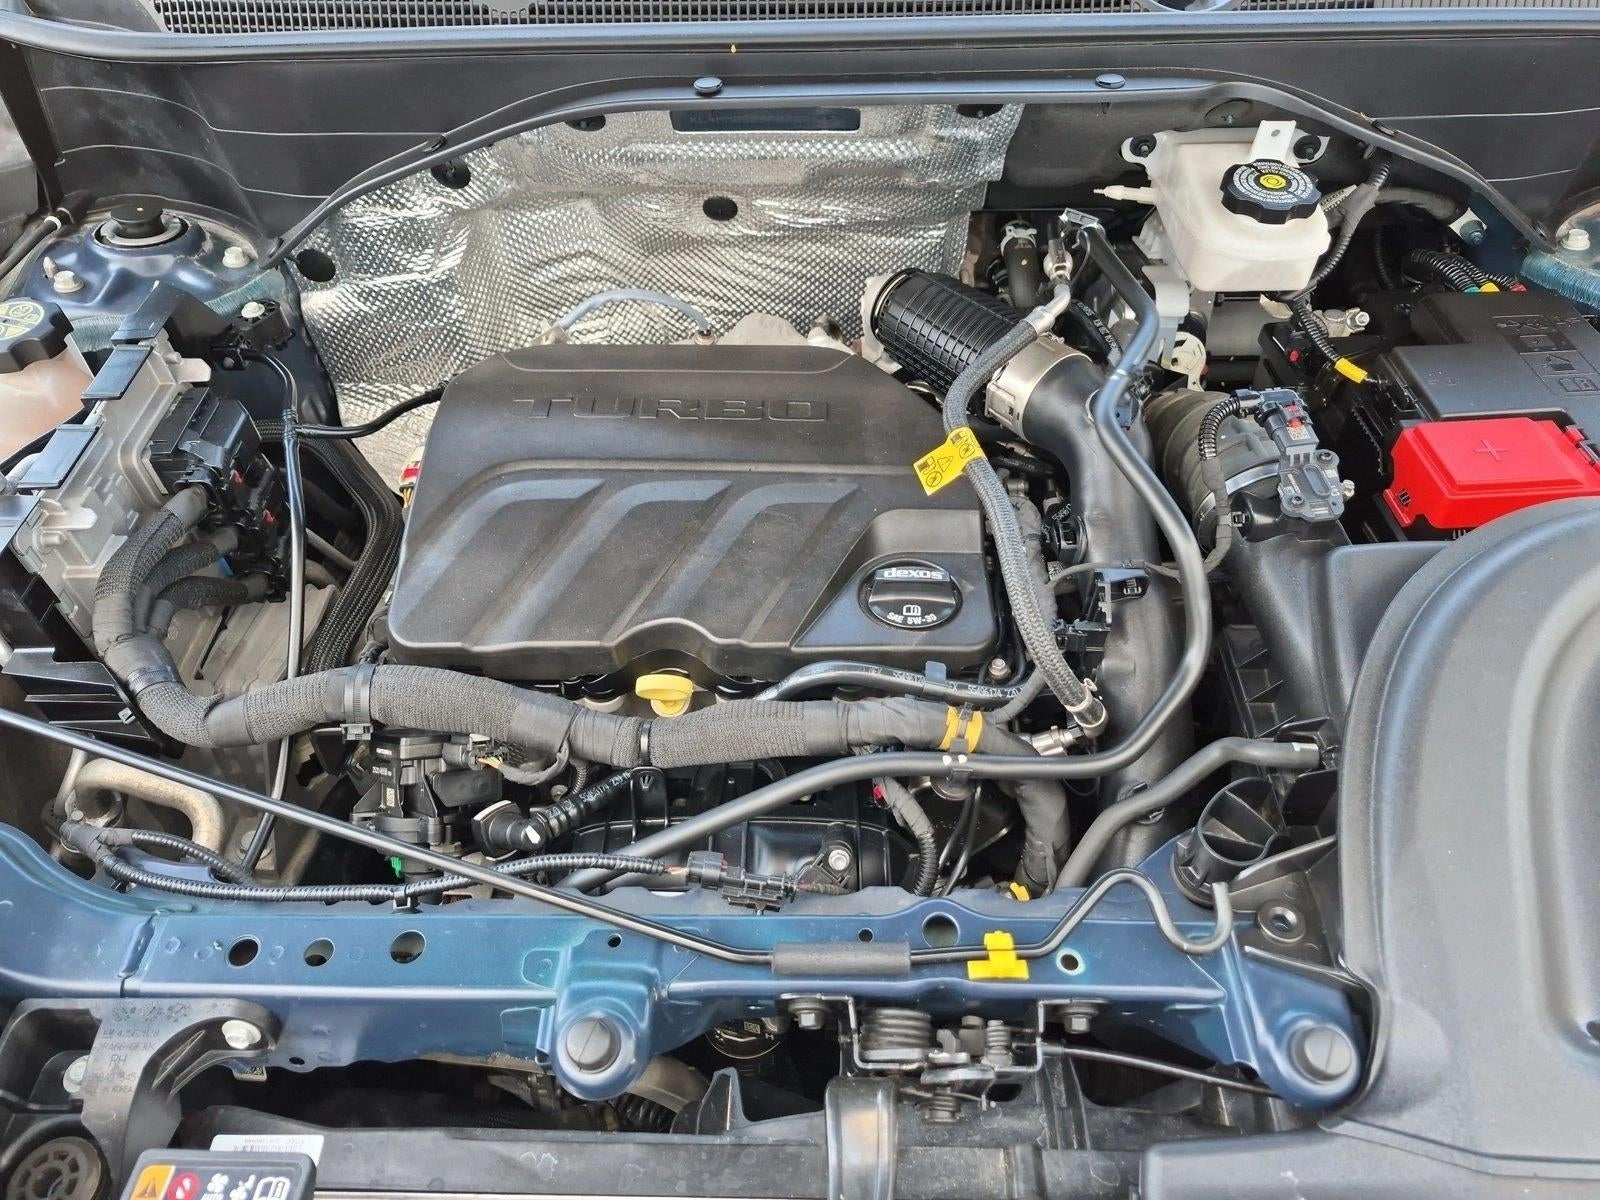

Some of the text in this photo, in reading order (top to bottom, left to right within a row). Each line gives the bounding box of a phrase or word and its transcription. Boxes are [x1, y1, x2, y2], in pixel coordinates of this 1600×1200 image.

[512, 397, 829, 422] TURBO
[884, 568, 944, 579] dexos
[887, 612, 937, 625] SAE 5W-30
[108, 1053, 128, 1066] RH
